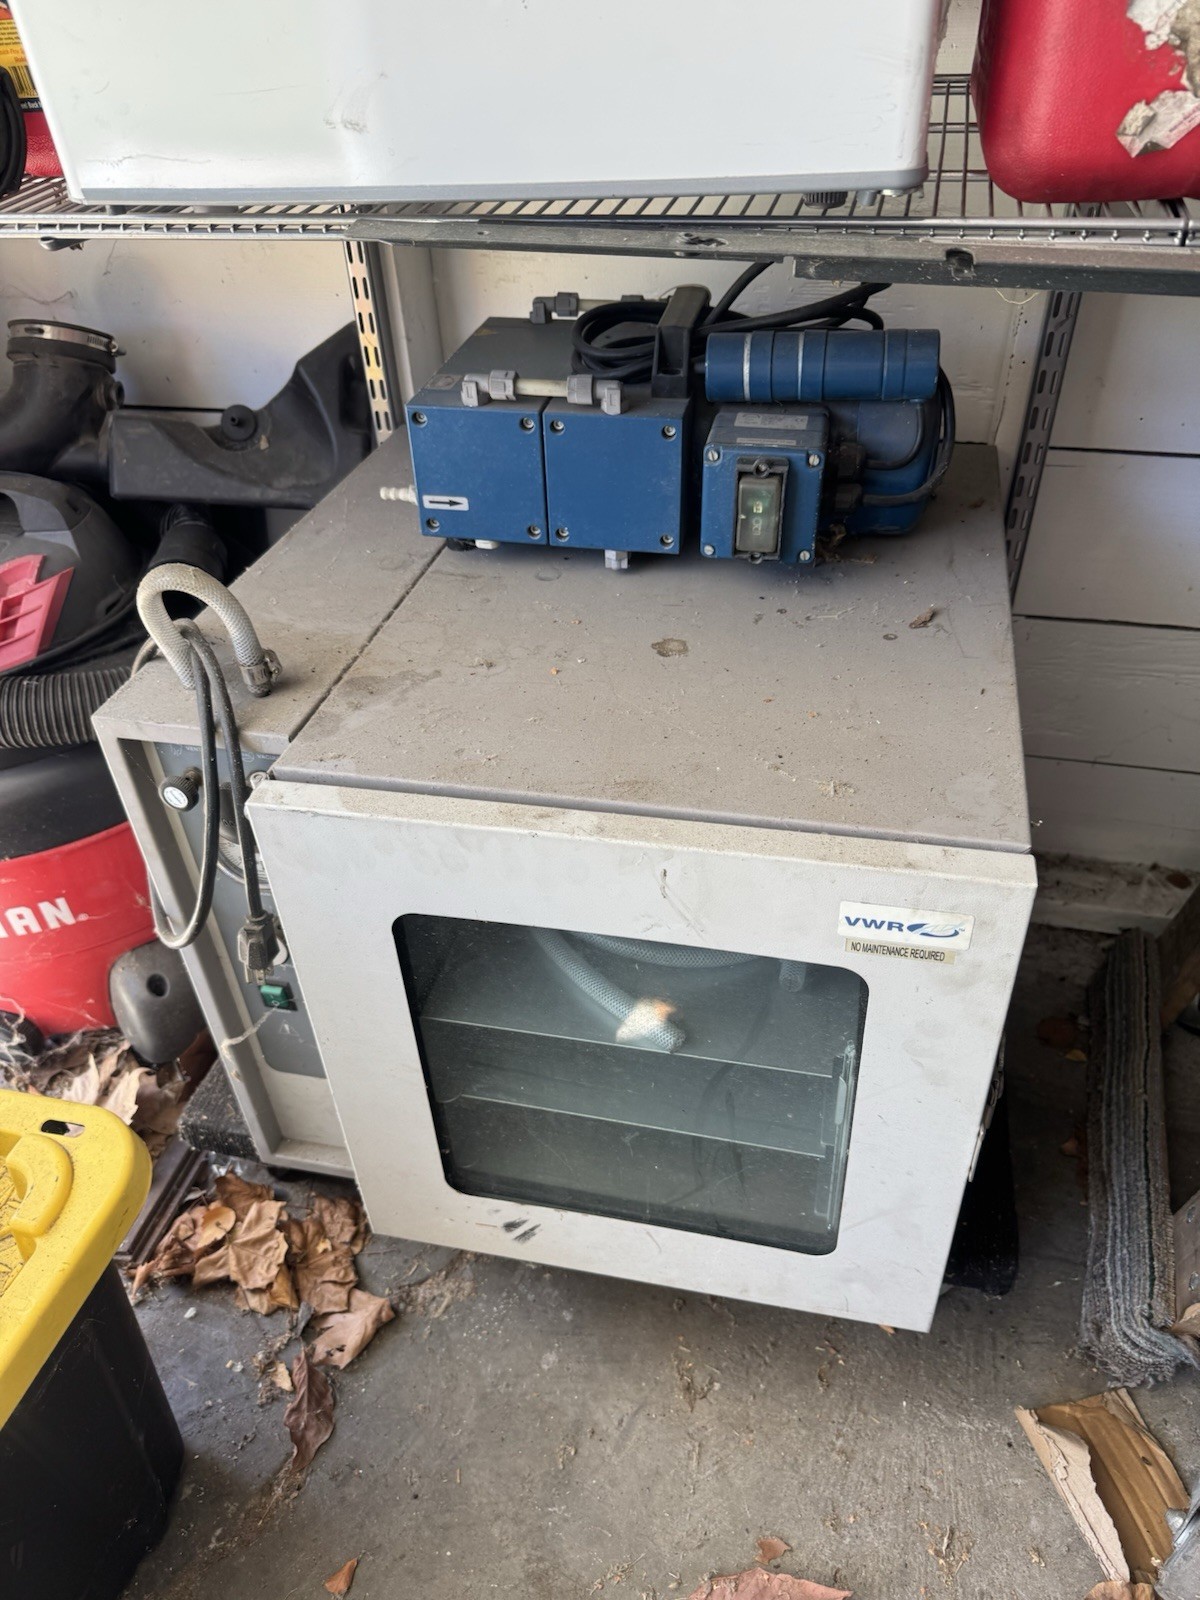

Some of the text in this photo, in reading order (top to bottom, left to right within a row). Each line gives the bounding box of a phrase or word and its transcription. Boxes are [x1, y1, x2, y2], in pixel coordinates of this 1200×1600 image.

[845, 916, 904, 932] VWR
[850, 942, 946, 962] NO MAINTENANCE REQUIRED
